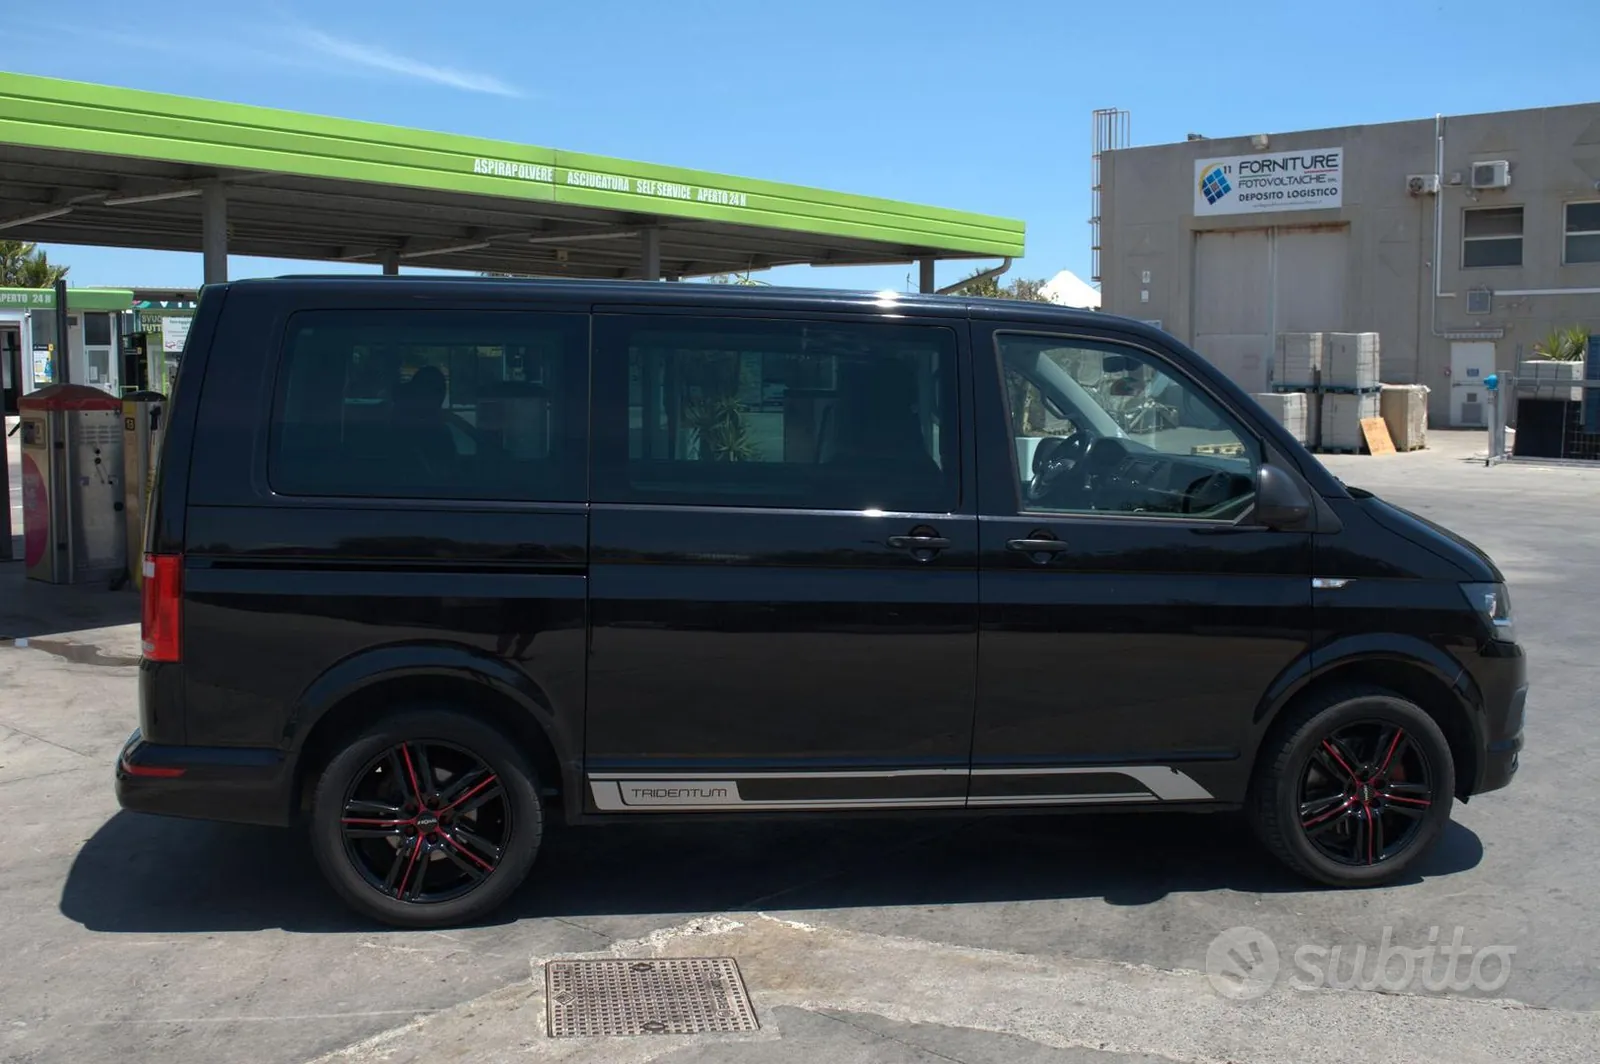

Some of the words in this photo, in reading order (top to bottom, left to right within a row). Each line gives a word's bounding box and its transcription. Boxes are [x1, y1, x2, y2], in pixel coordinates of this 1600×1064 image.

[473, 158, 553, 182] ASPIRAPOLVERE
[1239, 153, 1339, 175] FORNITURE
[567, 172, 630, 192] ASCIUGATURA
[636, 180, 656, 195] SELF
[656, 183, 692, 200] SERVICE
[1238, 174, 1326, 189] FOTOVOLTAICHE
[697, 187, 729, 205] APERTO
[1239, 190, 1284, 202] DEPOSITO
[1287, 187, 1338, 199] LOGISTICO
[0, 293, 28, 303] PERTO
[32, 294, 43, 304] 24
[631, 788, 728, 798] TRIDENTUM
